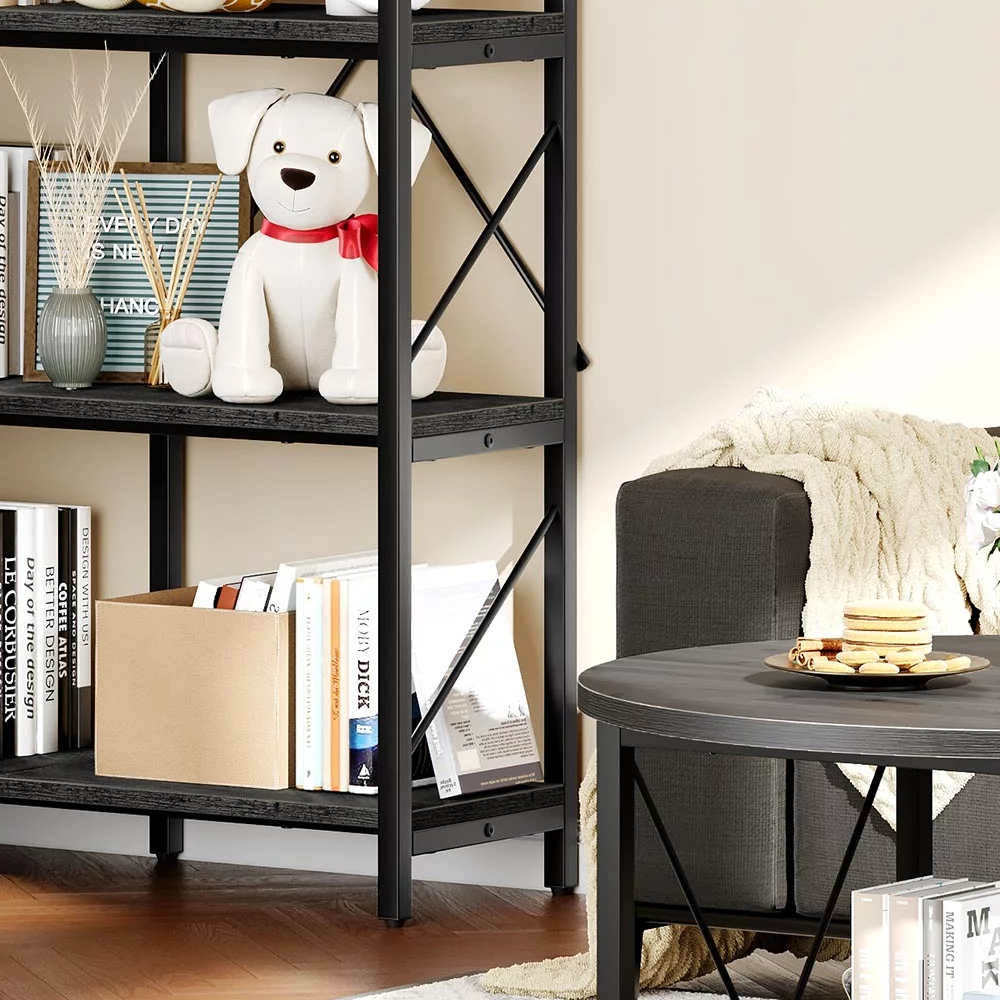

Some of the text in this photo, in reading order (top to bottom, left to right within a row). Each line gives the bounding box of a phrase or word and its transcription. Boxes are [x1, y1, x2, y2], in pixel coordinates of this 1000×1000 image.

[4, 557, 16, 723] LE CORBUSIER
[24, 557, 34, 720] Day of the design
[45, 566, 54, 703] BETTER DESIGN
[58, 582, 67, 679] COFFEE ATLAS
[357, 660, 370, 709] DICK
[945, 911, 955, 962] MAKING
[946, 966, 955, 979] IT
